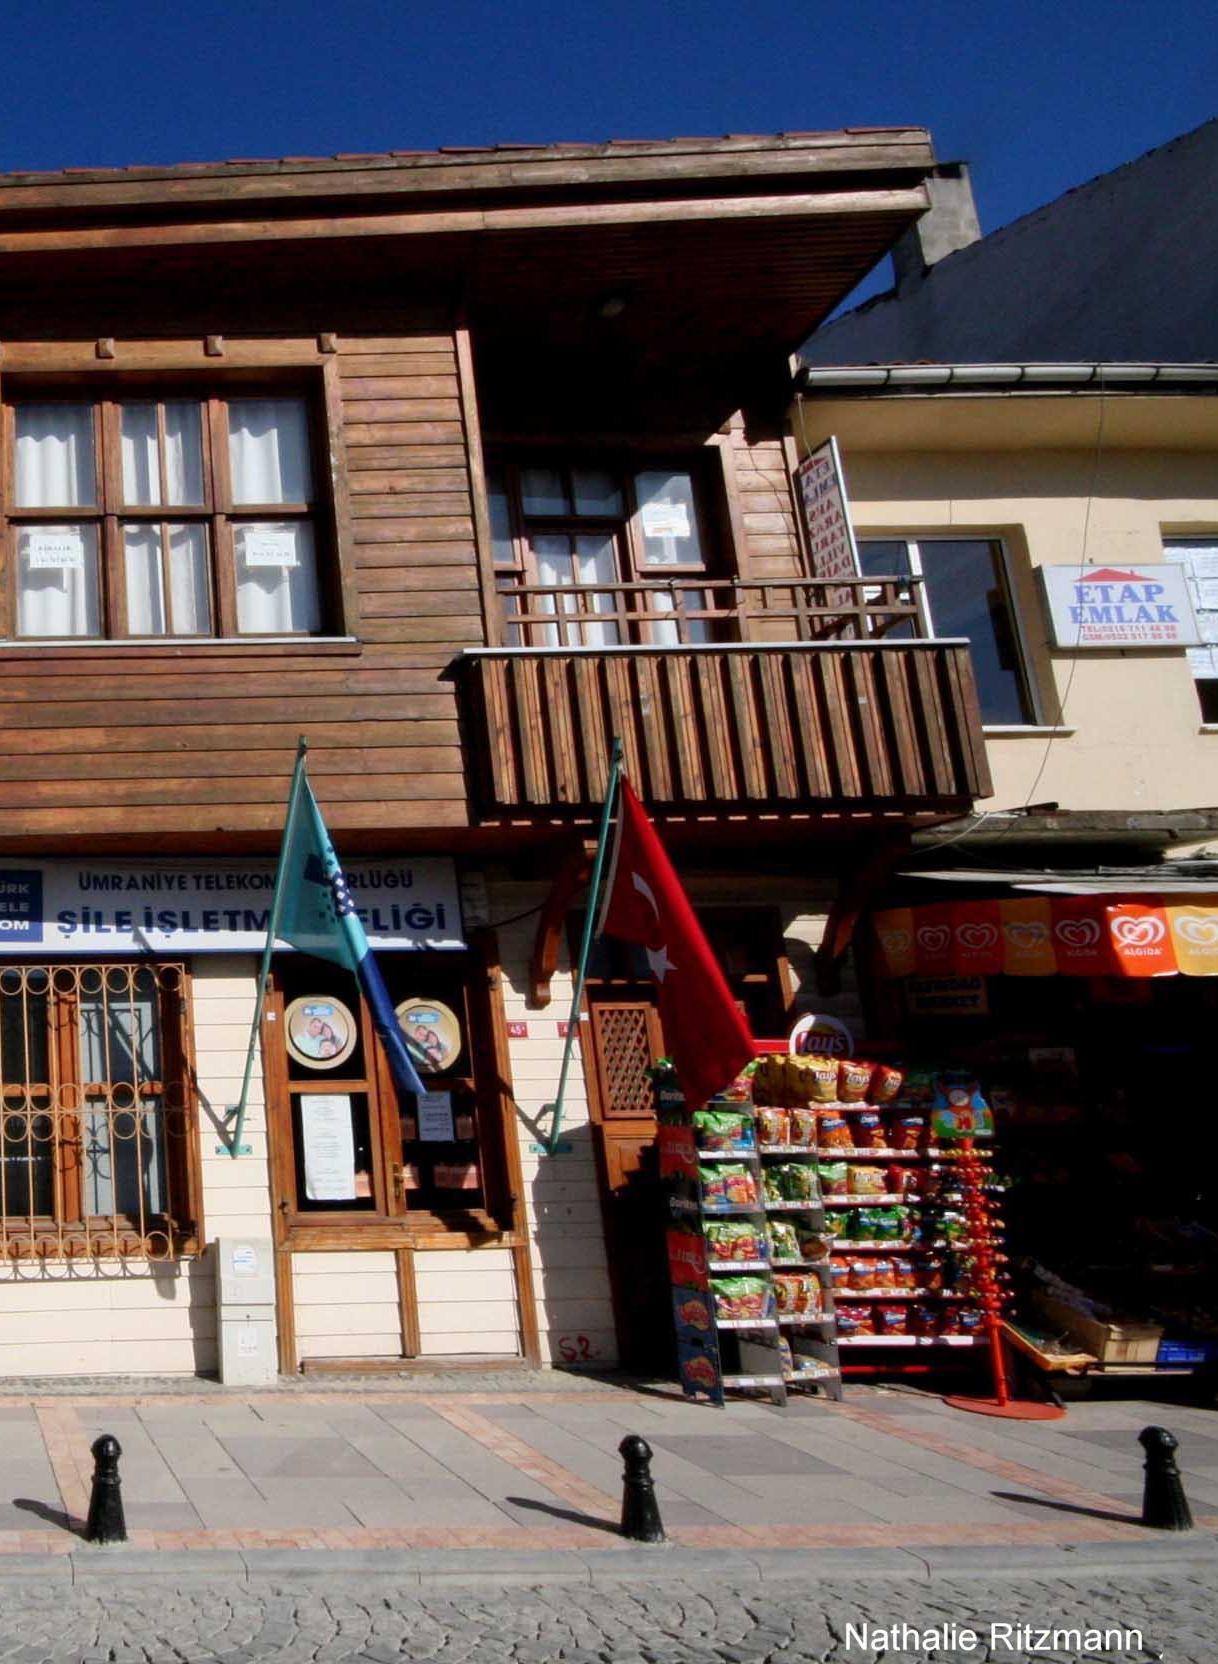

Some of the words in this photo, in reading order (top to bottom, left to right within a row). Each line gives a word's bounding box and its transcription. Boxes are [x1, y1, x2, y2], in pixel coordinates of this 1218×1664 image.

[1073, 584, 1165, 604] ETAP
[1069, 605, 1180, 624] EMLAK
[78, 871, 187, 891] ÜMRANİYE
[345, 869, 414, 889] RLÜĞÜ
[57, 906, 133, 939] ŞİLE
[145, 905, 271, 939] İŞLETM
